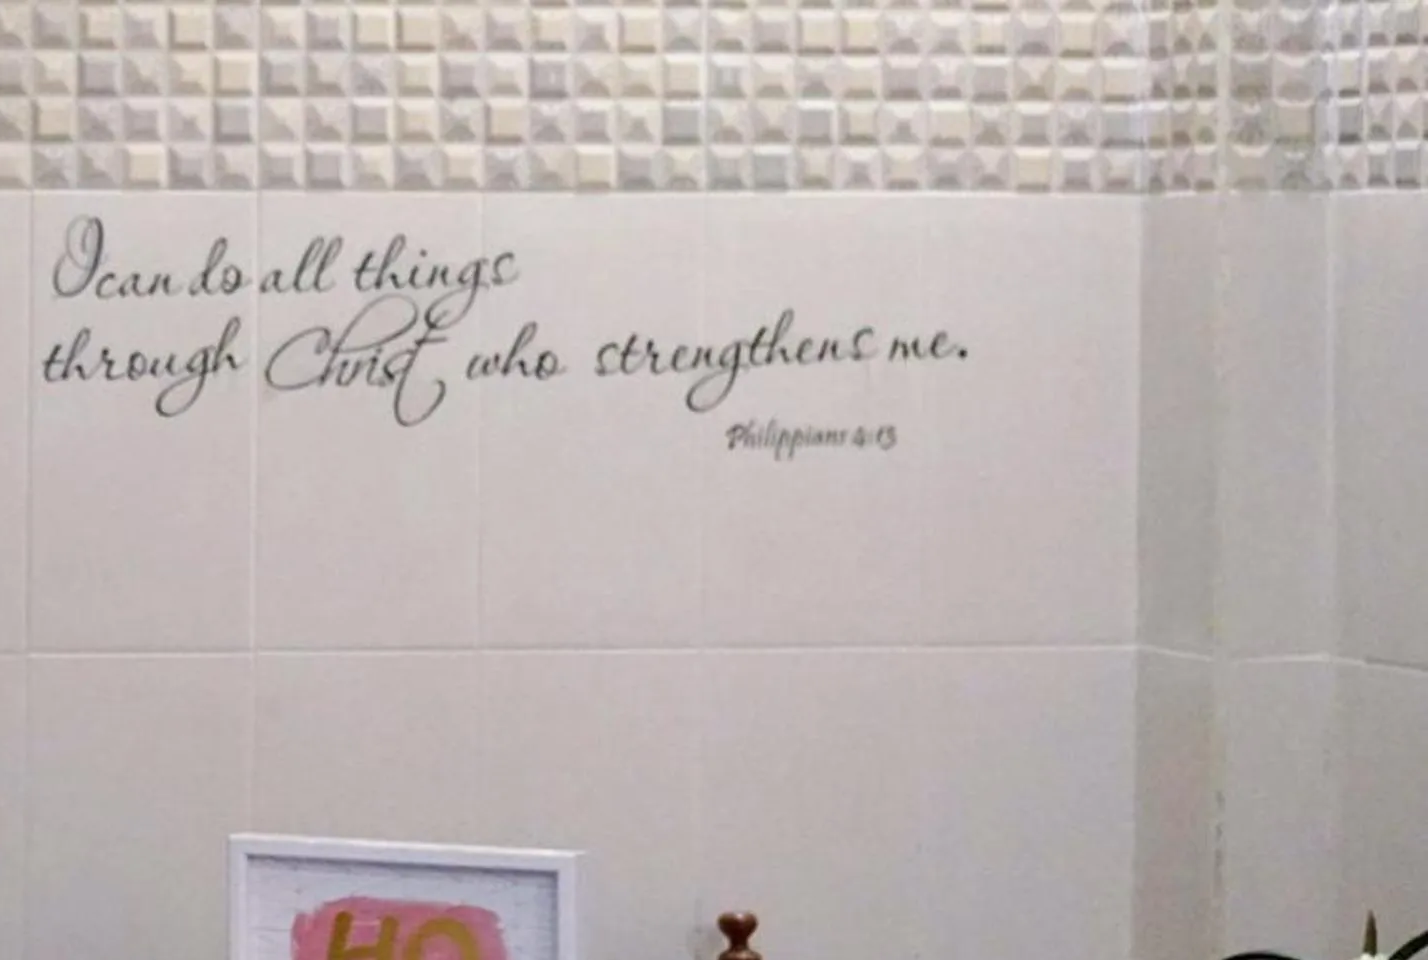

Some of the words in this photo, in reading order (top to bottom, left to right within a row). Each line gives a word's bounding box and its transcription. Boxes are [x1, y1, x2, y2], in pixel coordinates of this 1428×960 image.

[95, 270, 172, 299] can
[188, 238, 244, 297] do
[259, 236, 341, 293] all
[354, 233, 519, 330] things
[42, 317, 240, 418] through
[265, 292, 447, 427] Christ
[465, 321, 563, 380] who
[594, 308, 874, 413] strengthens
[887, 330, 969, 363] me.
